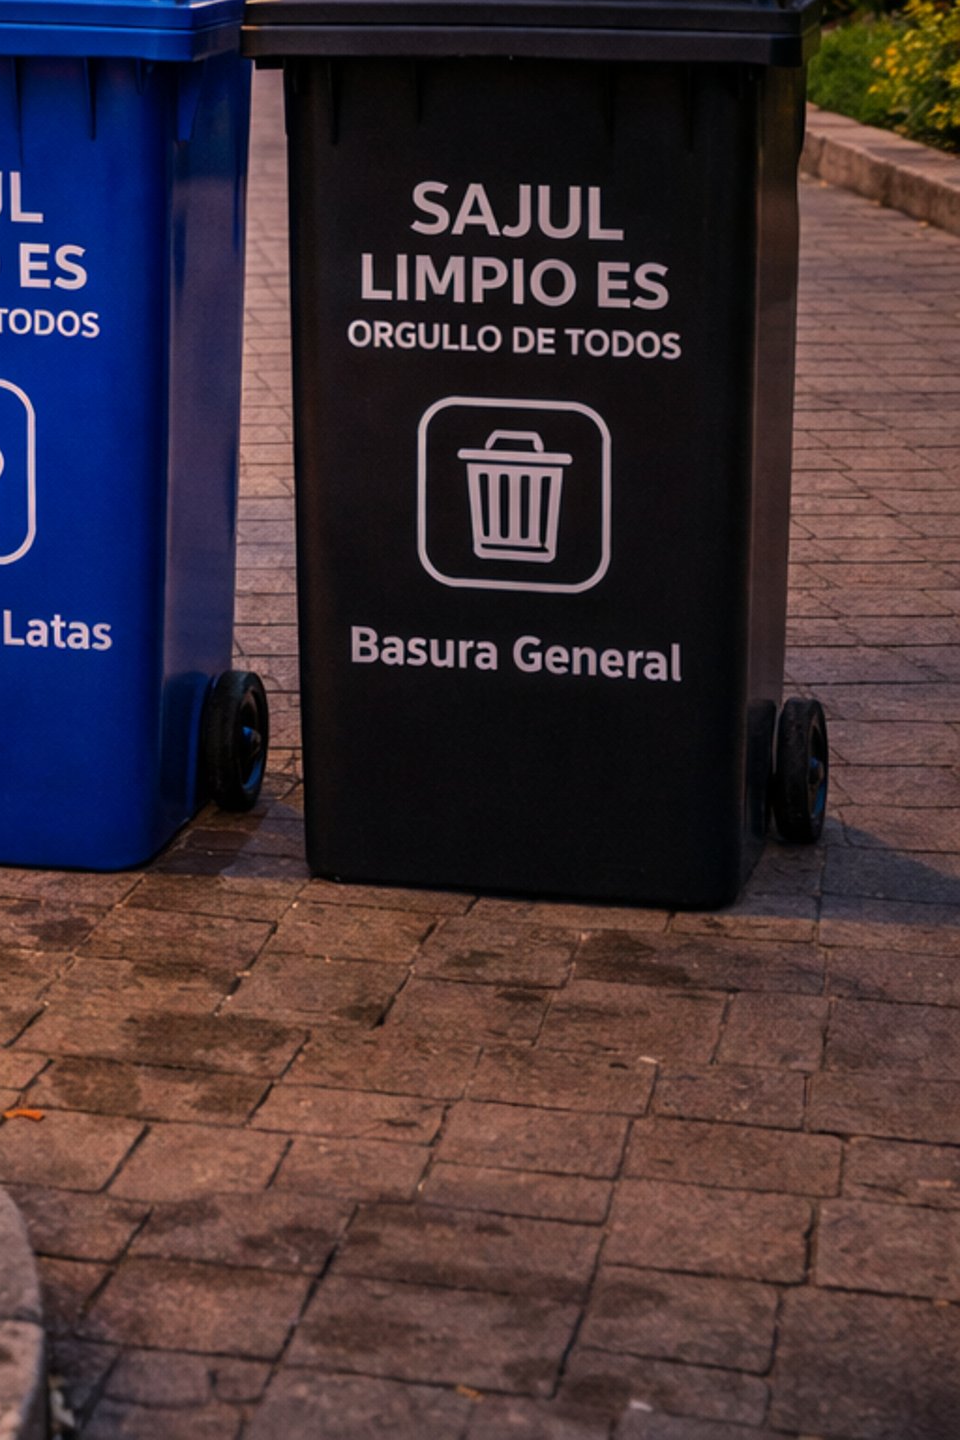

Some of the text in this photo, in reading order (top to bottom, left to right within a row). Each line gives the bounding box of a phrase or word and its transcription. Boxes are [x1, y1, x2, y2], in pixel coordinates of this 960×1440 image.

[411, 181, 624, 241] SAJUL
[19, 242, 88, 290] ES
[361, 253, 669, 310] LIMPIO ES
[347, 319, 681, 359] ORGULLO DE TODOS
[3, 609, 112, 651] Latas
[351, 626, 681, 682] Basura General
